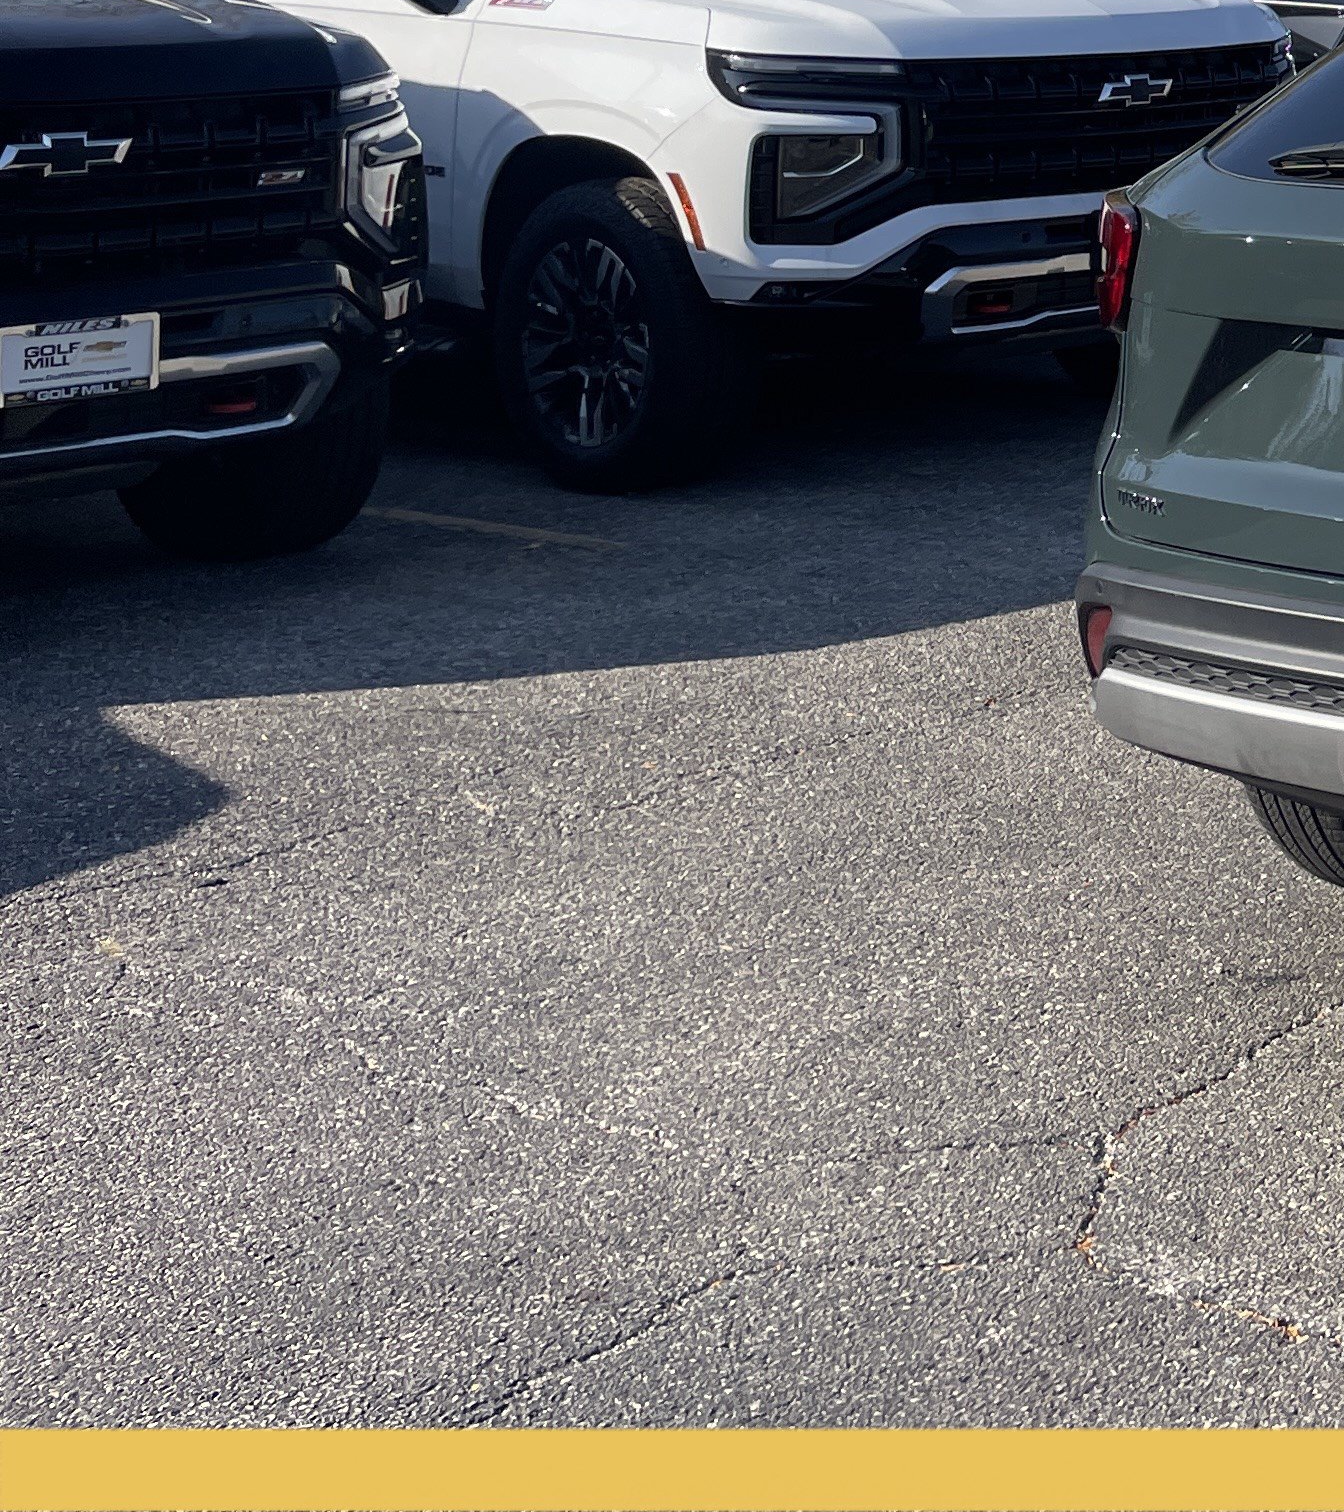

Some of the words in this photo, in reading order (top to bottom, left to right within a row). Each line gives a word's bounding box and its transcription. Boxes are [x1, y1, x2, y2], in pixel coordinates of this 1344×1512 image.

[40, 318, 116, 335] NILES
[24, 341, 81, 358] GOLF
[24, 355, 70, 370] MILL
[37, 387, 79, 400] GOLF
[81, 382, 119, 396] MILL
